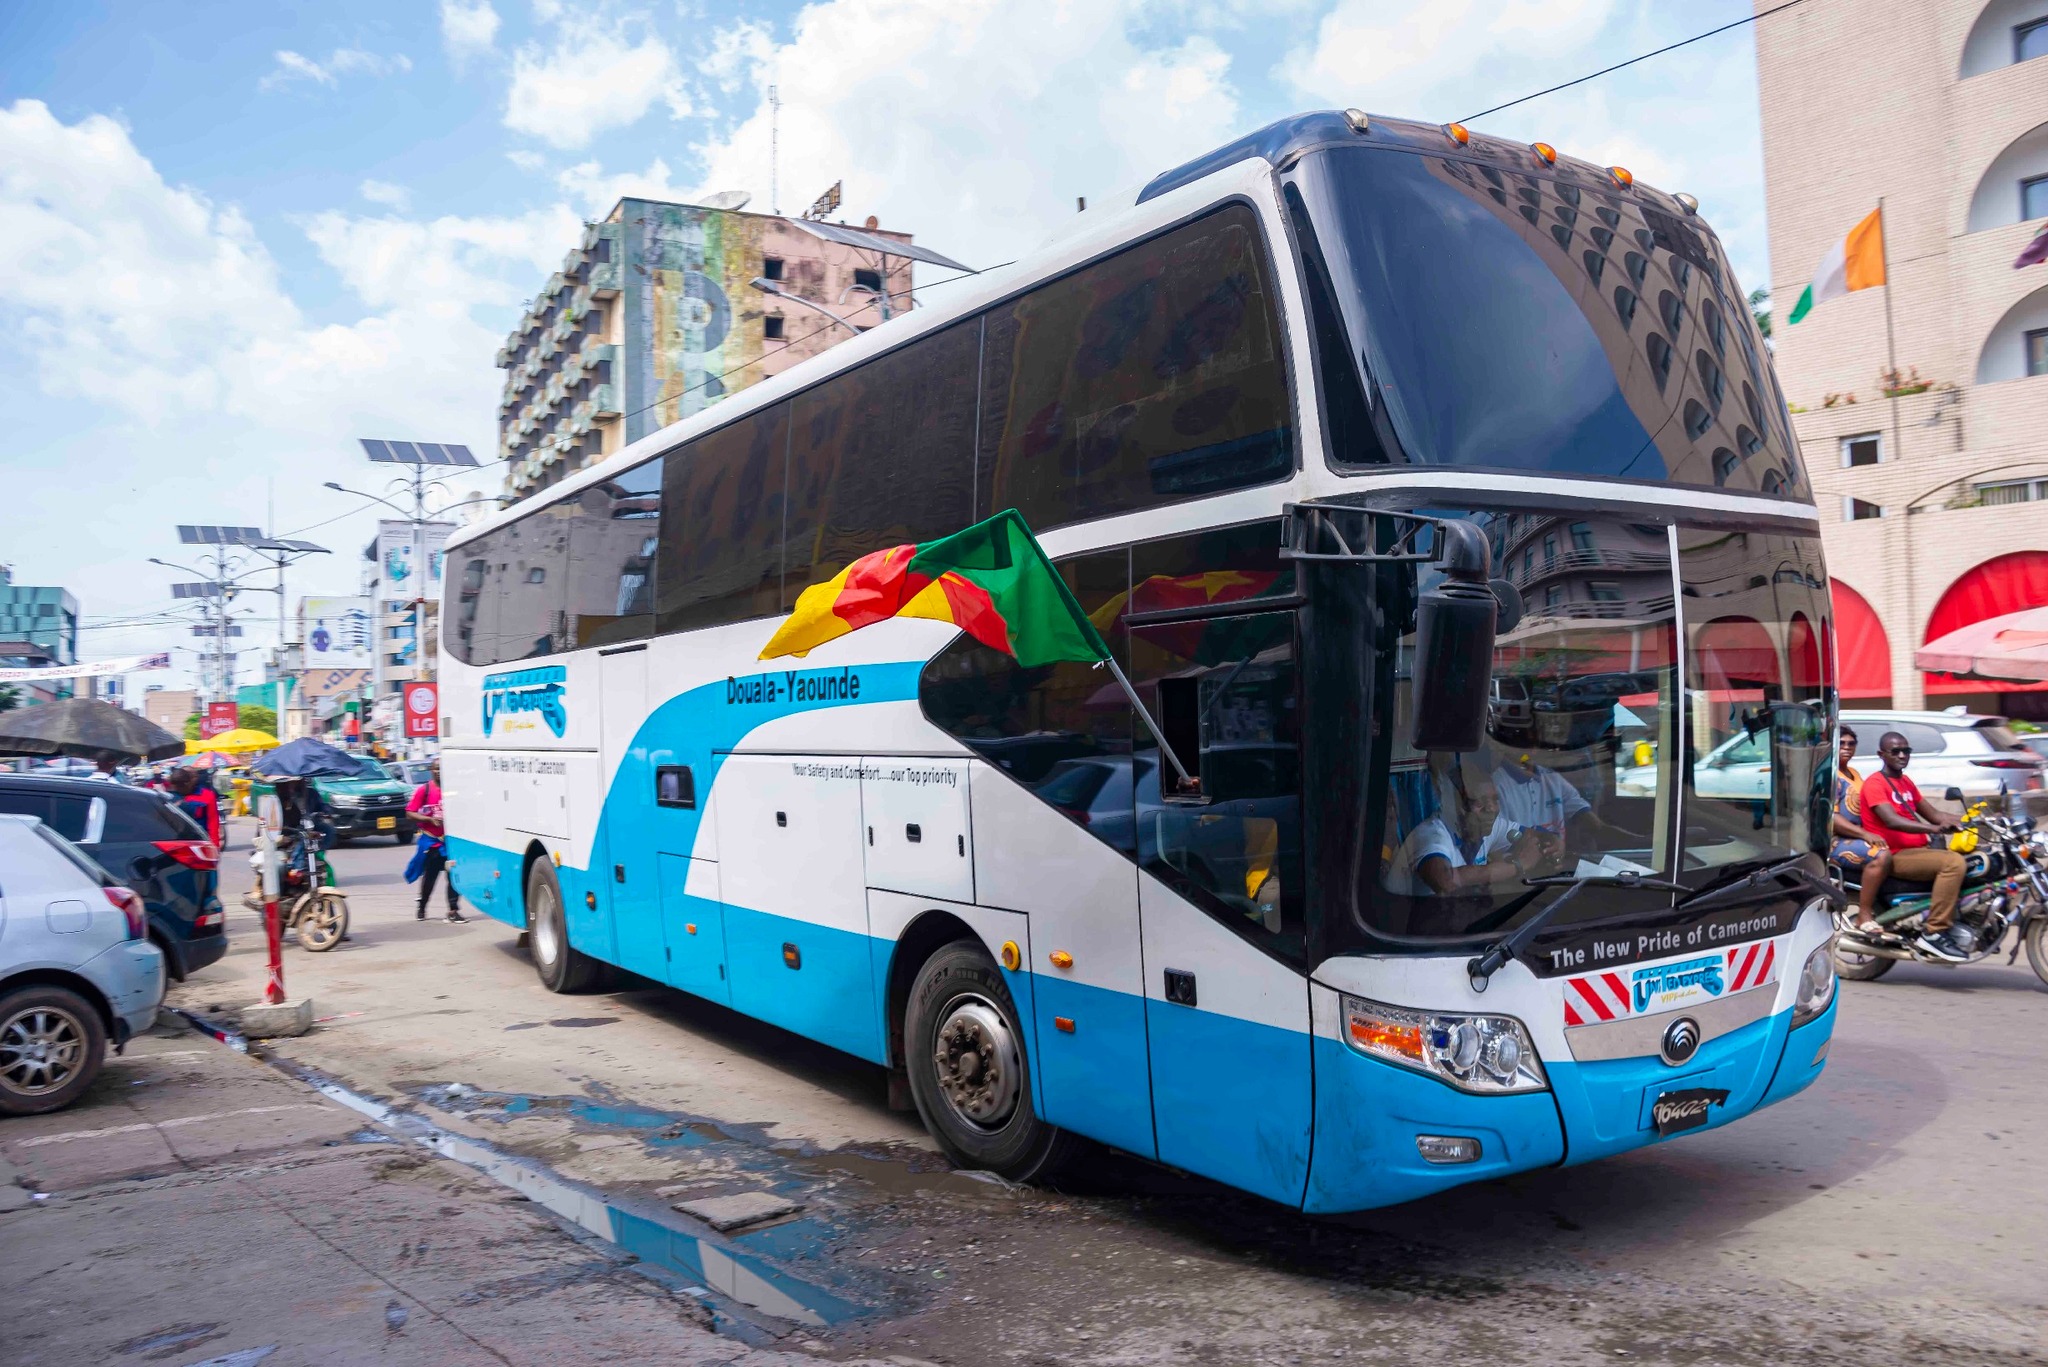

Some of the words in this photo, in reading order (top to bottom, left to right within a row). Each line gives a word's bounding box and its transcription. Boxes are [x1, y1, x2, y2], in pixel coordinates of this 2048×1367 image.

[727, 666, 860, 704] Douala-Yaounde
[412, 717, 436, 732] LG
[792, 763, 806, 776] Your
[808, 764, 829, 781] Safety
[830, 765, 843, 778] and
[906, 767, 921, 786] Top
[923, 767, 957, 788] priority
[1550, 949, 1585, 968] The
[1593, 941, 1630, 961] New
[1638, 932, 1681, 953] Pride
[1687, 923, 1703, 944] of
[1708, 914, 1777, 941] Cameroon
